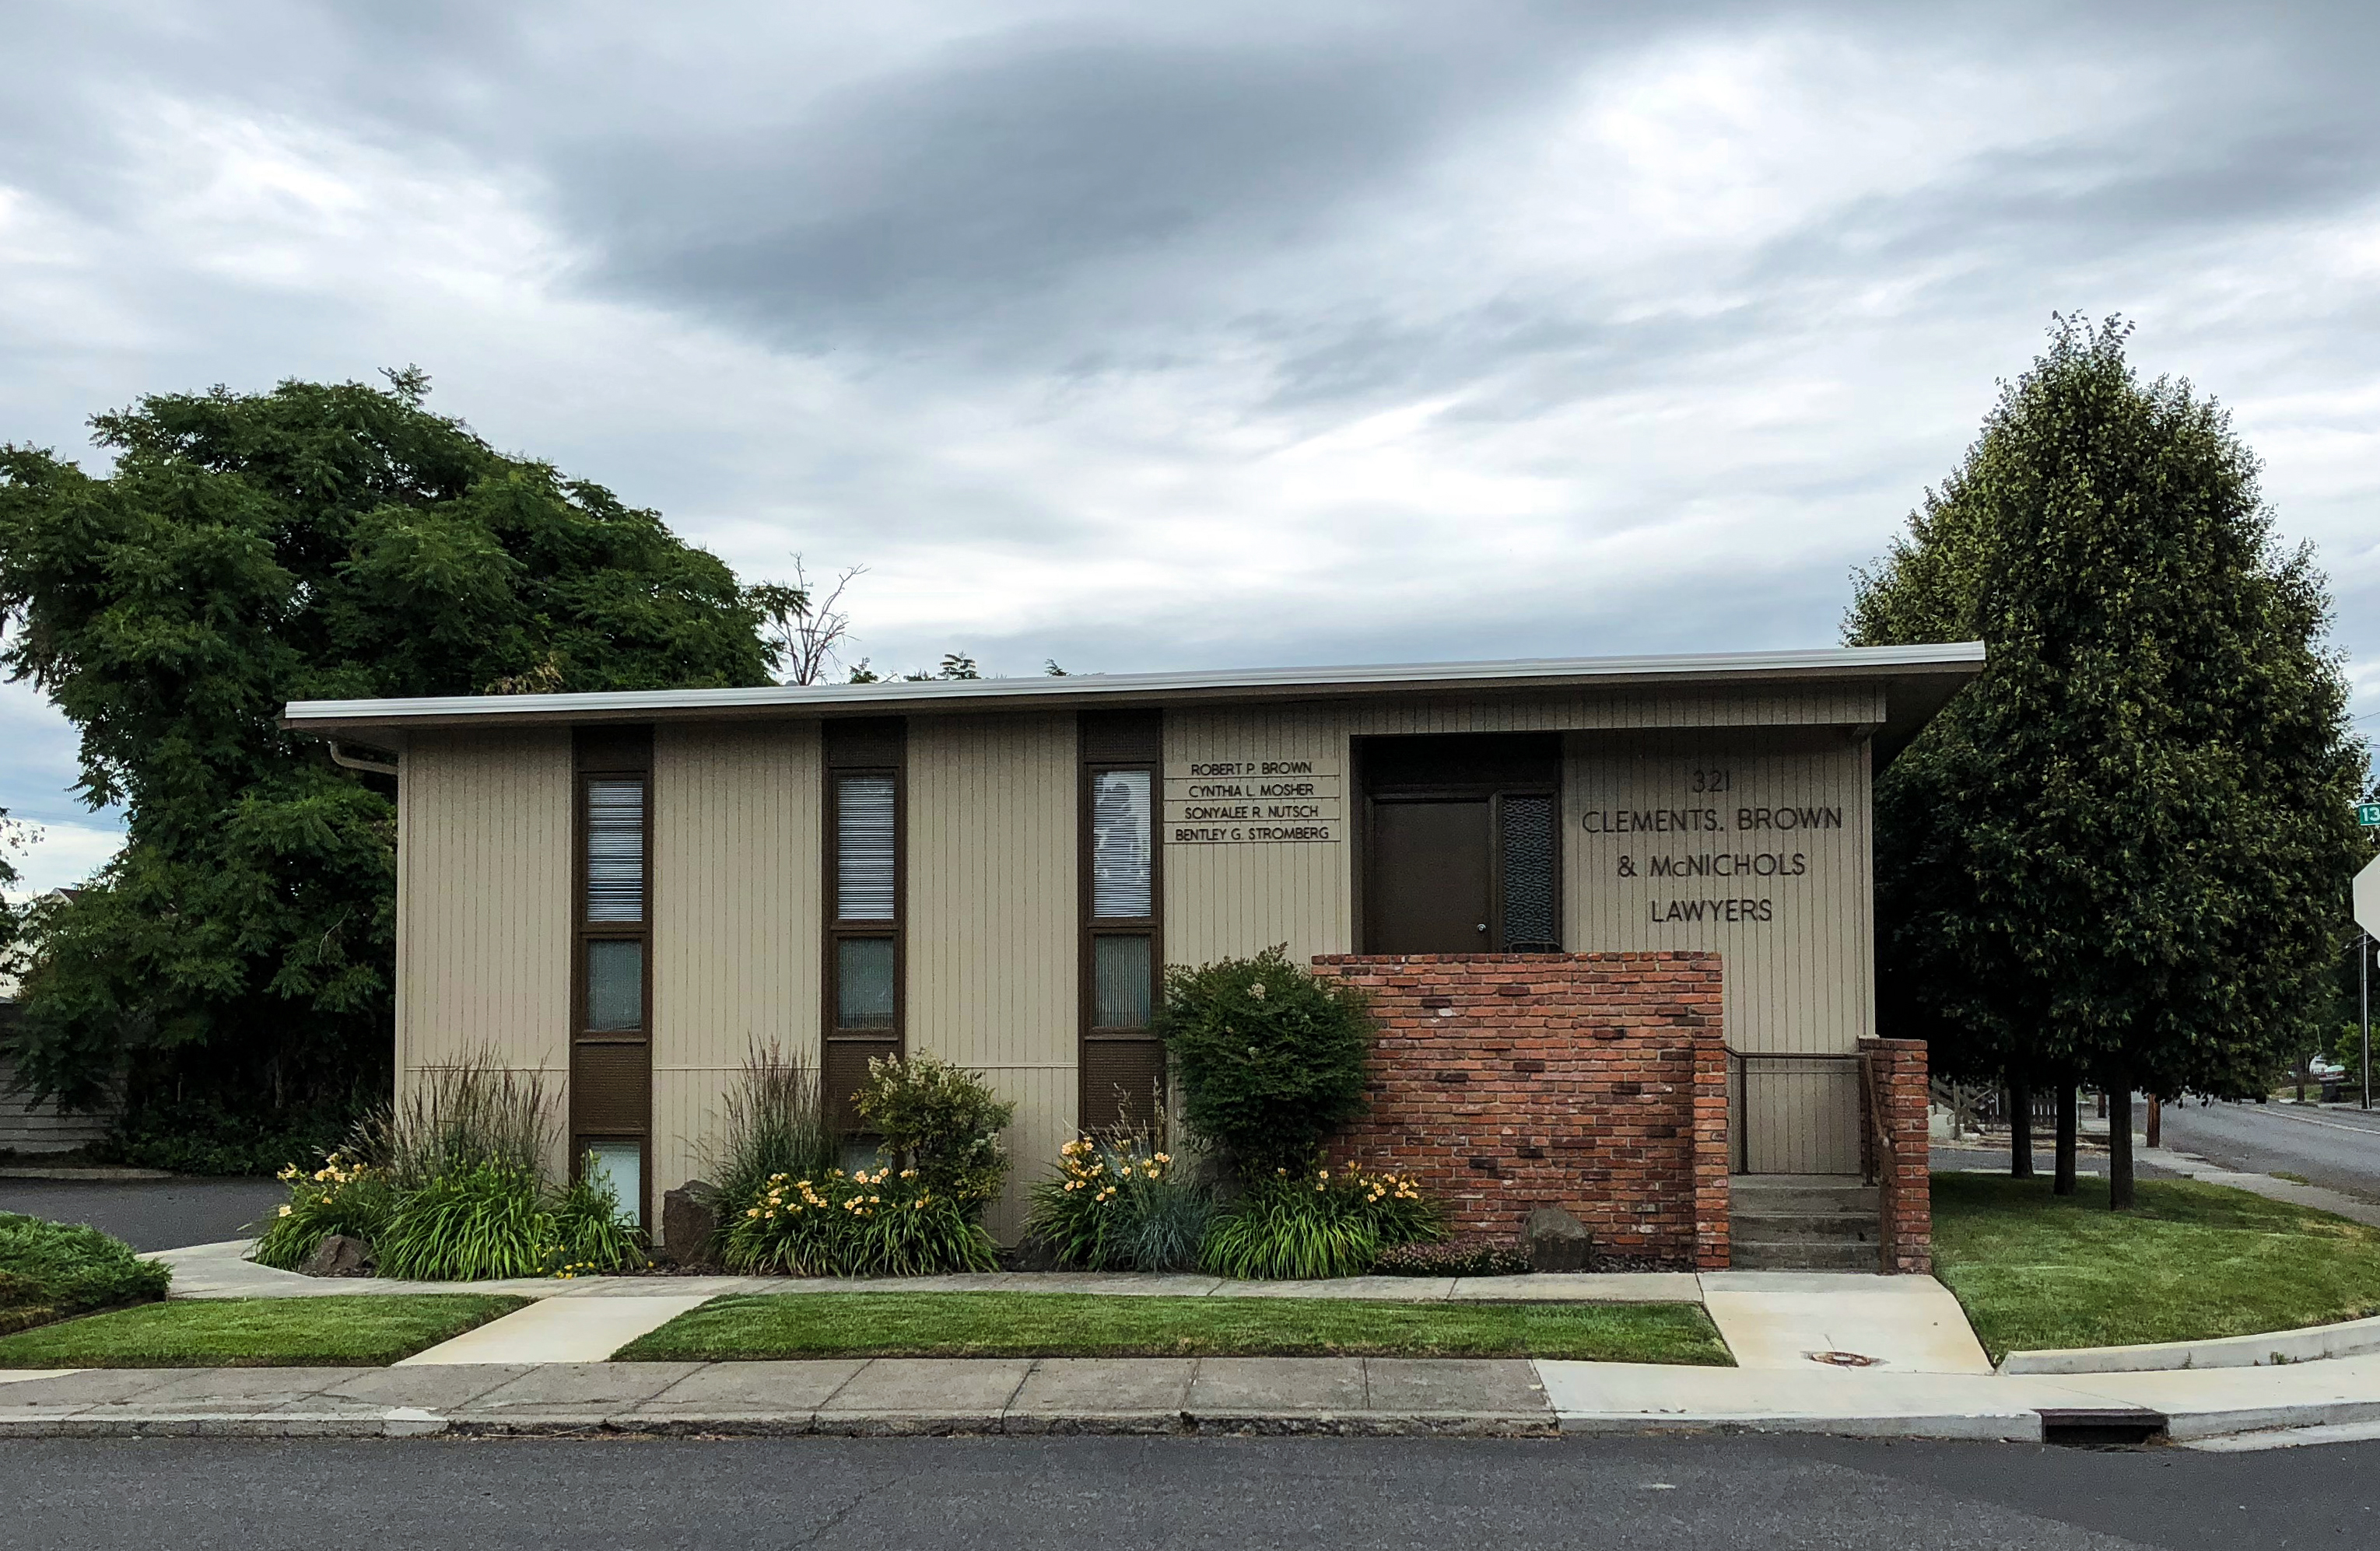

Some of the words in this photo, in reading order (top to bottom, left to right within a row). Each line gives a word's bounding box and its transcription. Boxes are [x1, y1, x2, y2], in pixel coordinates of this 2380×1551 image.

[1191, 764, 1243, 776] ROBERT
[1262, 761, 1313, 774] BROWN
[1189, 786, 1243, 797] CYNTHIA
[1260, 783, 1314, 796] MOSHER
[1692, 769, 1730, 793] 321
[1185, 806, 1248, 819] SONYALEE
[1268, 805, 1319, 818] NUTSCH
[1737, 807, 1842, 832] BROWN
[1176, 828, 1227, 841] BENTLEY
[1248, 827, 1329, 840] STROMBERG
[1618, 855, 1638, 878] &
[1649, 853, 1806, 877] McNICHOLS
[1651, 898, 1772, 923] LAWYERS
